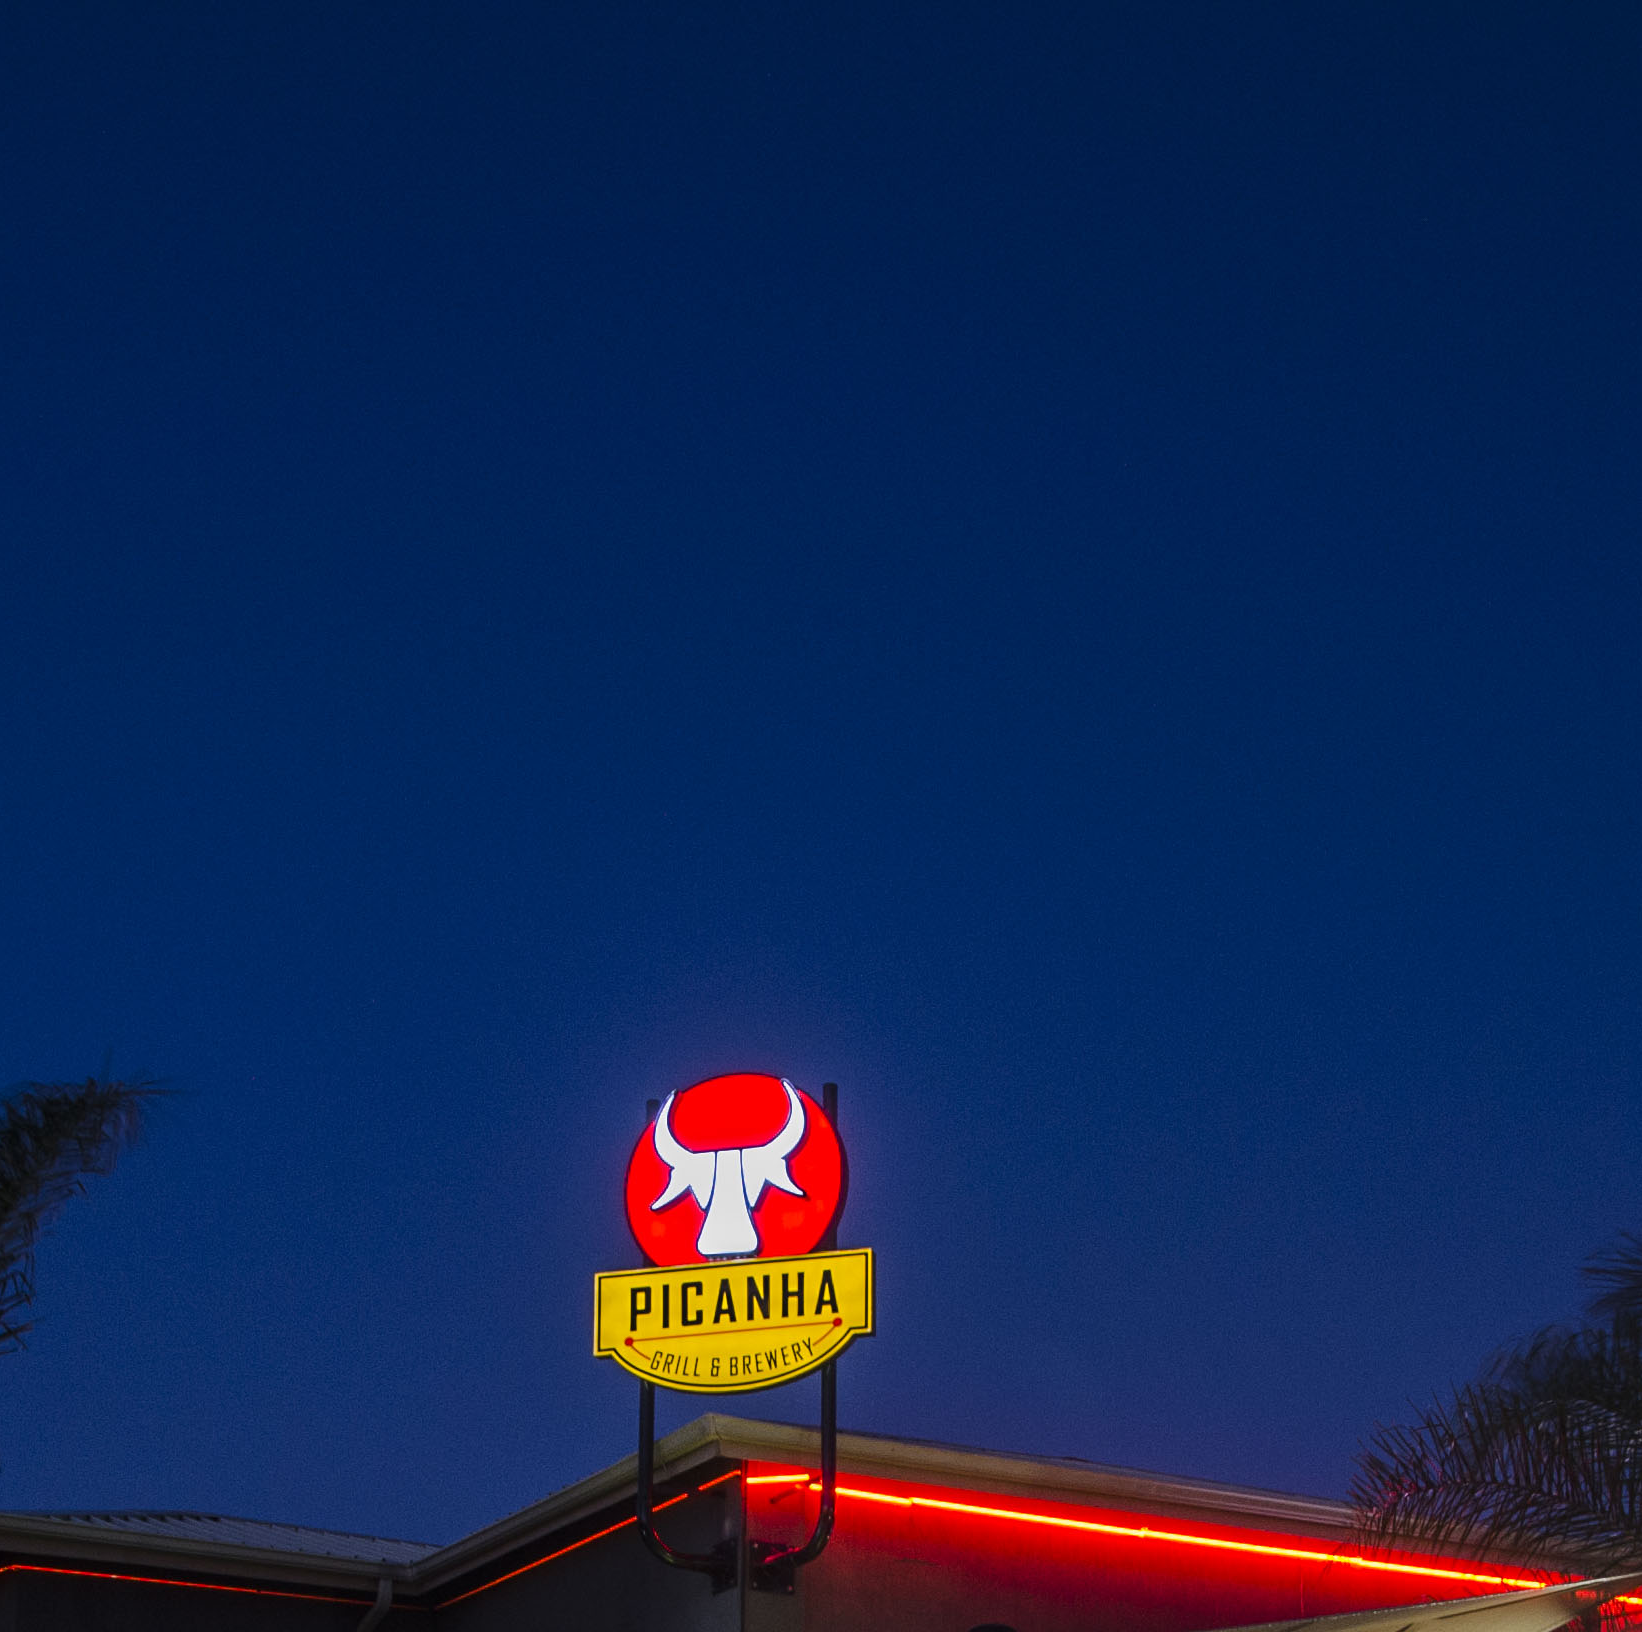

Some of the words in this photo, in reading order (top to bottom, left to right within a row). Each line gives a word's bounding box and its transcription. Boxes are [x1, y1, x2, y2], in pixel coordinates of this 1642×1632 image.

[630, 1269, 839, 1331] PICANHA
[650, 1350, 701, 1377] GRILL
[711, 1358, 720, 1377] &
[730, 1338, 814, 1376] BREWERY
